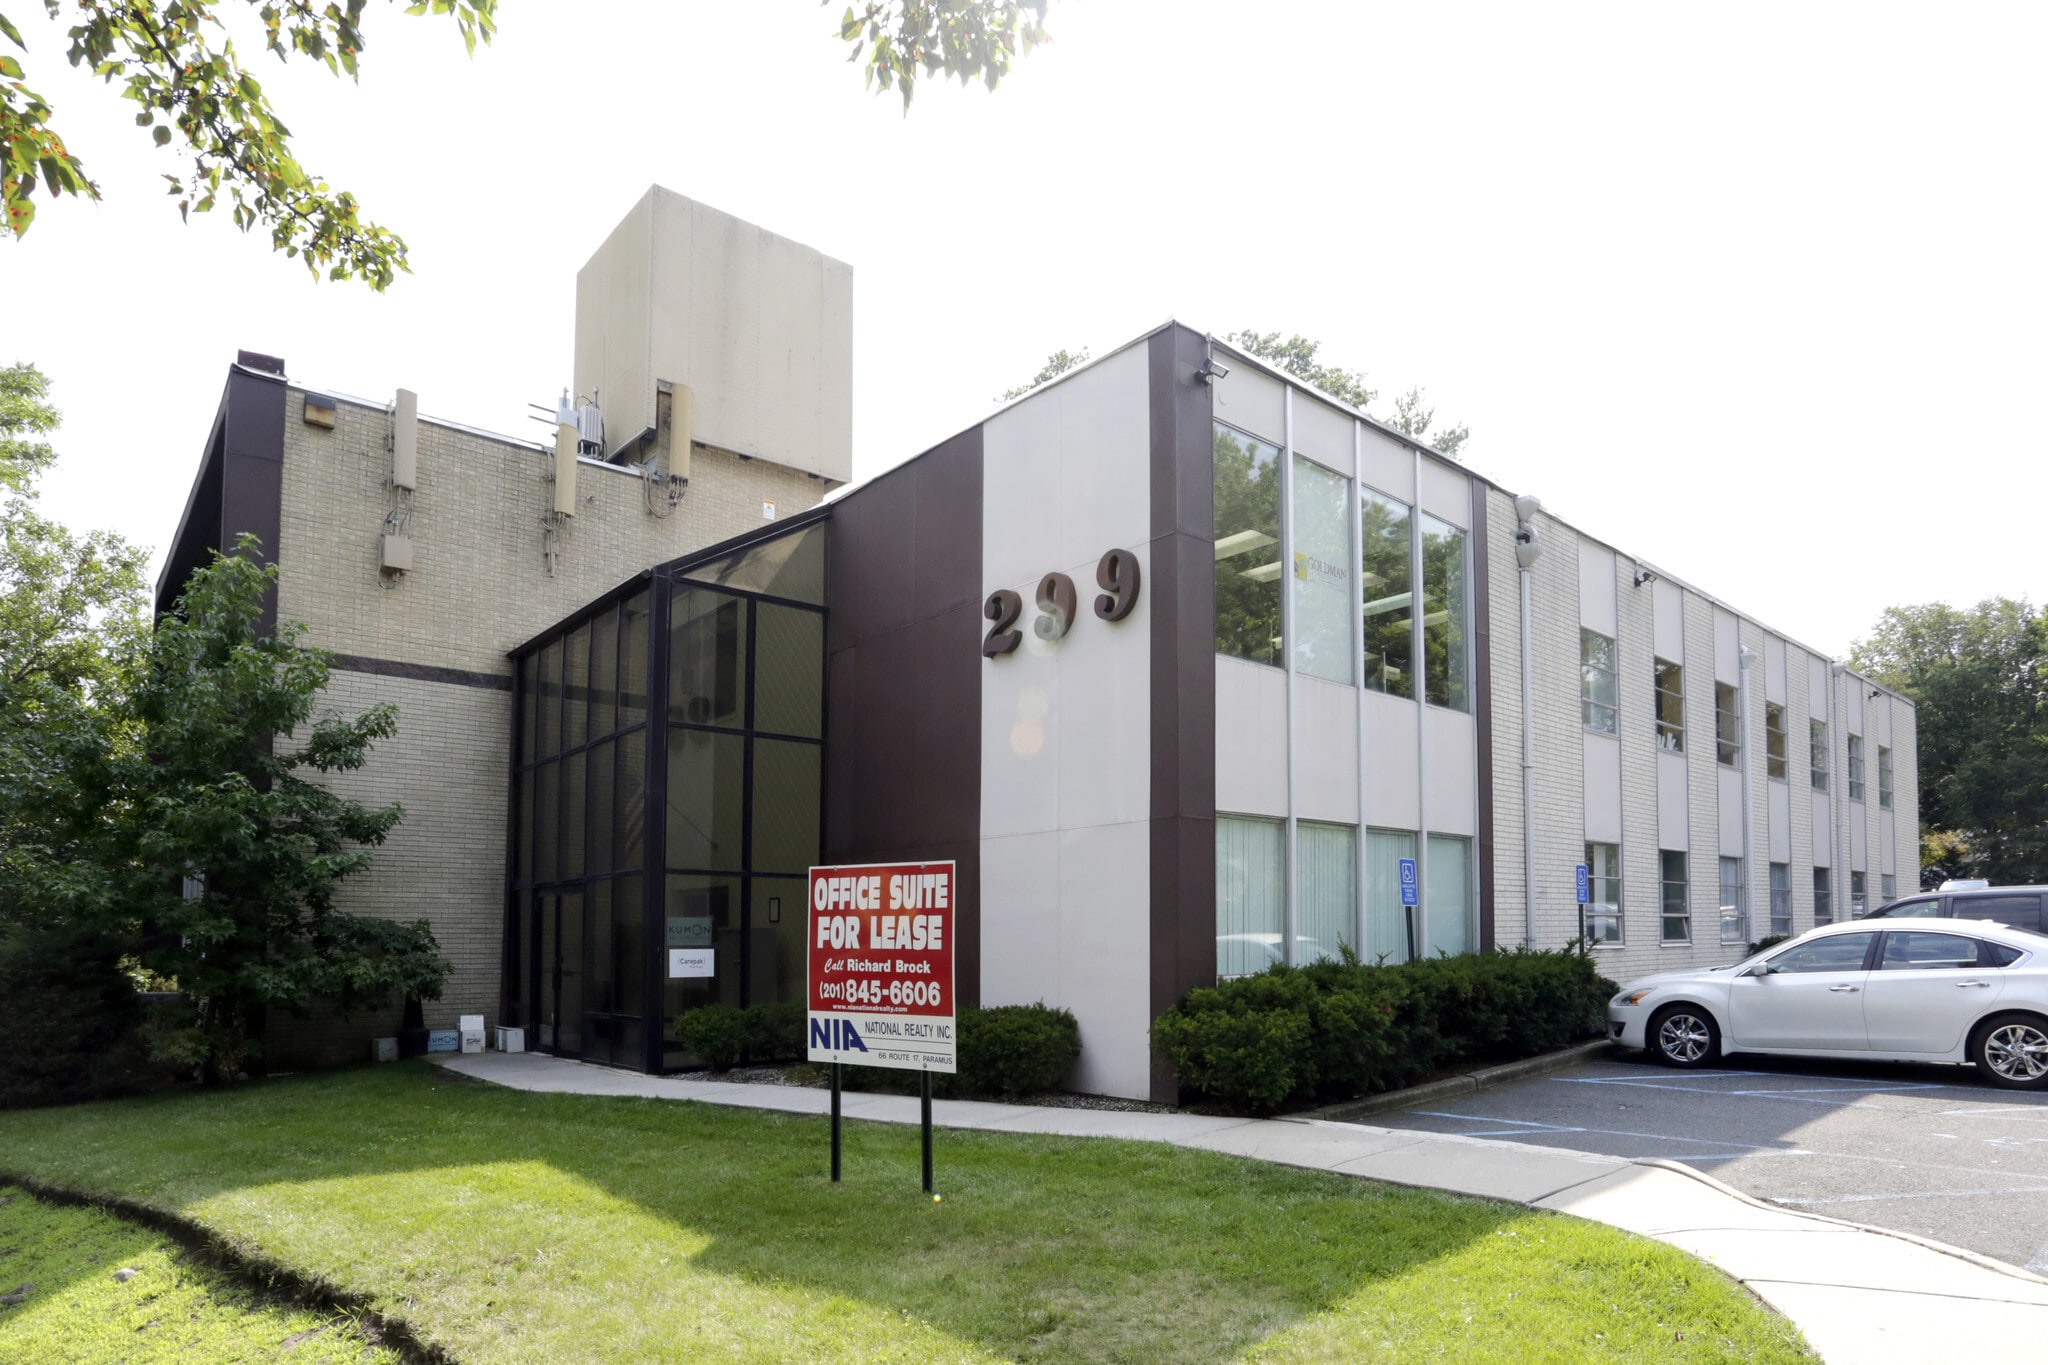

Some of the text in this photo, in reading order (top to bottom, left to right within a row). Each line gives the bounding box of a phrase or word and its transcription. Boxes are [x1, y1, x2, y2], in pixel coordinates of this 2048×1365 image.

[983, 548, 1141, 660] 299
[814, 873, 949, 911] OFFICE SUITE
[668, 924, 711, 936] KUMON
[817, 914, 943, 950] FOR LEASE
[824, 958, 931, 974] Call Richard Brock
[810, 1017, 953, 1053] NIA NATIONAL REALTY INC.
[878, 1051, 887, 1060] 66
[888, 1053, 910, 1061] ROUTE
[922, 1055, 953, 1065] PARAMUS
